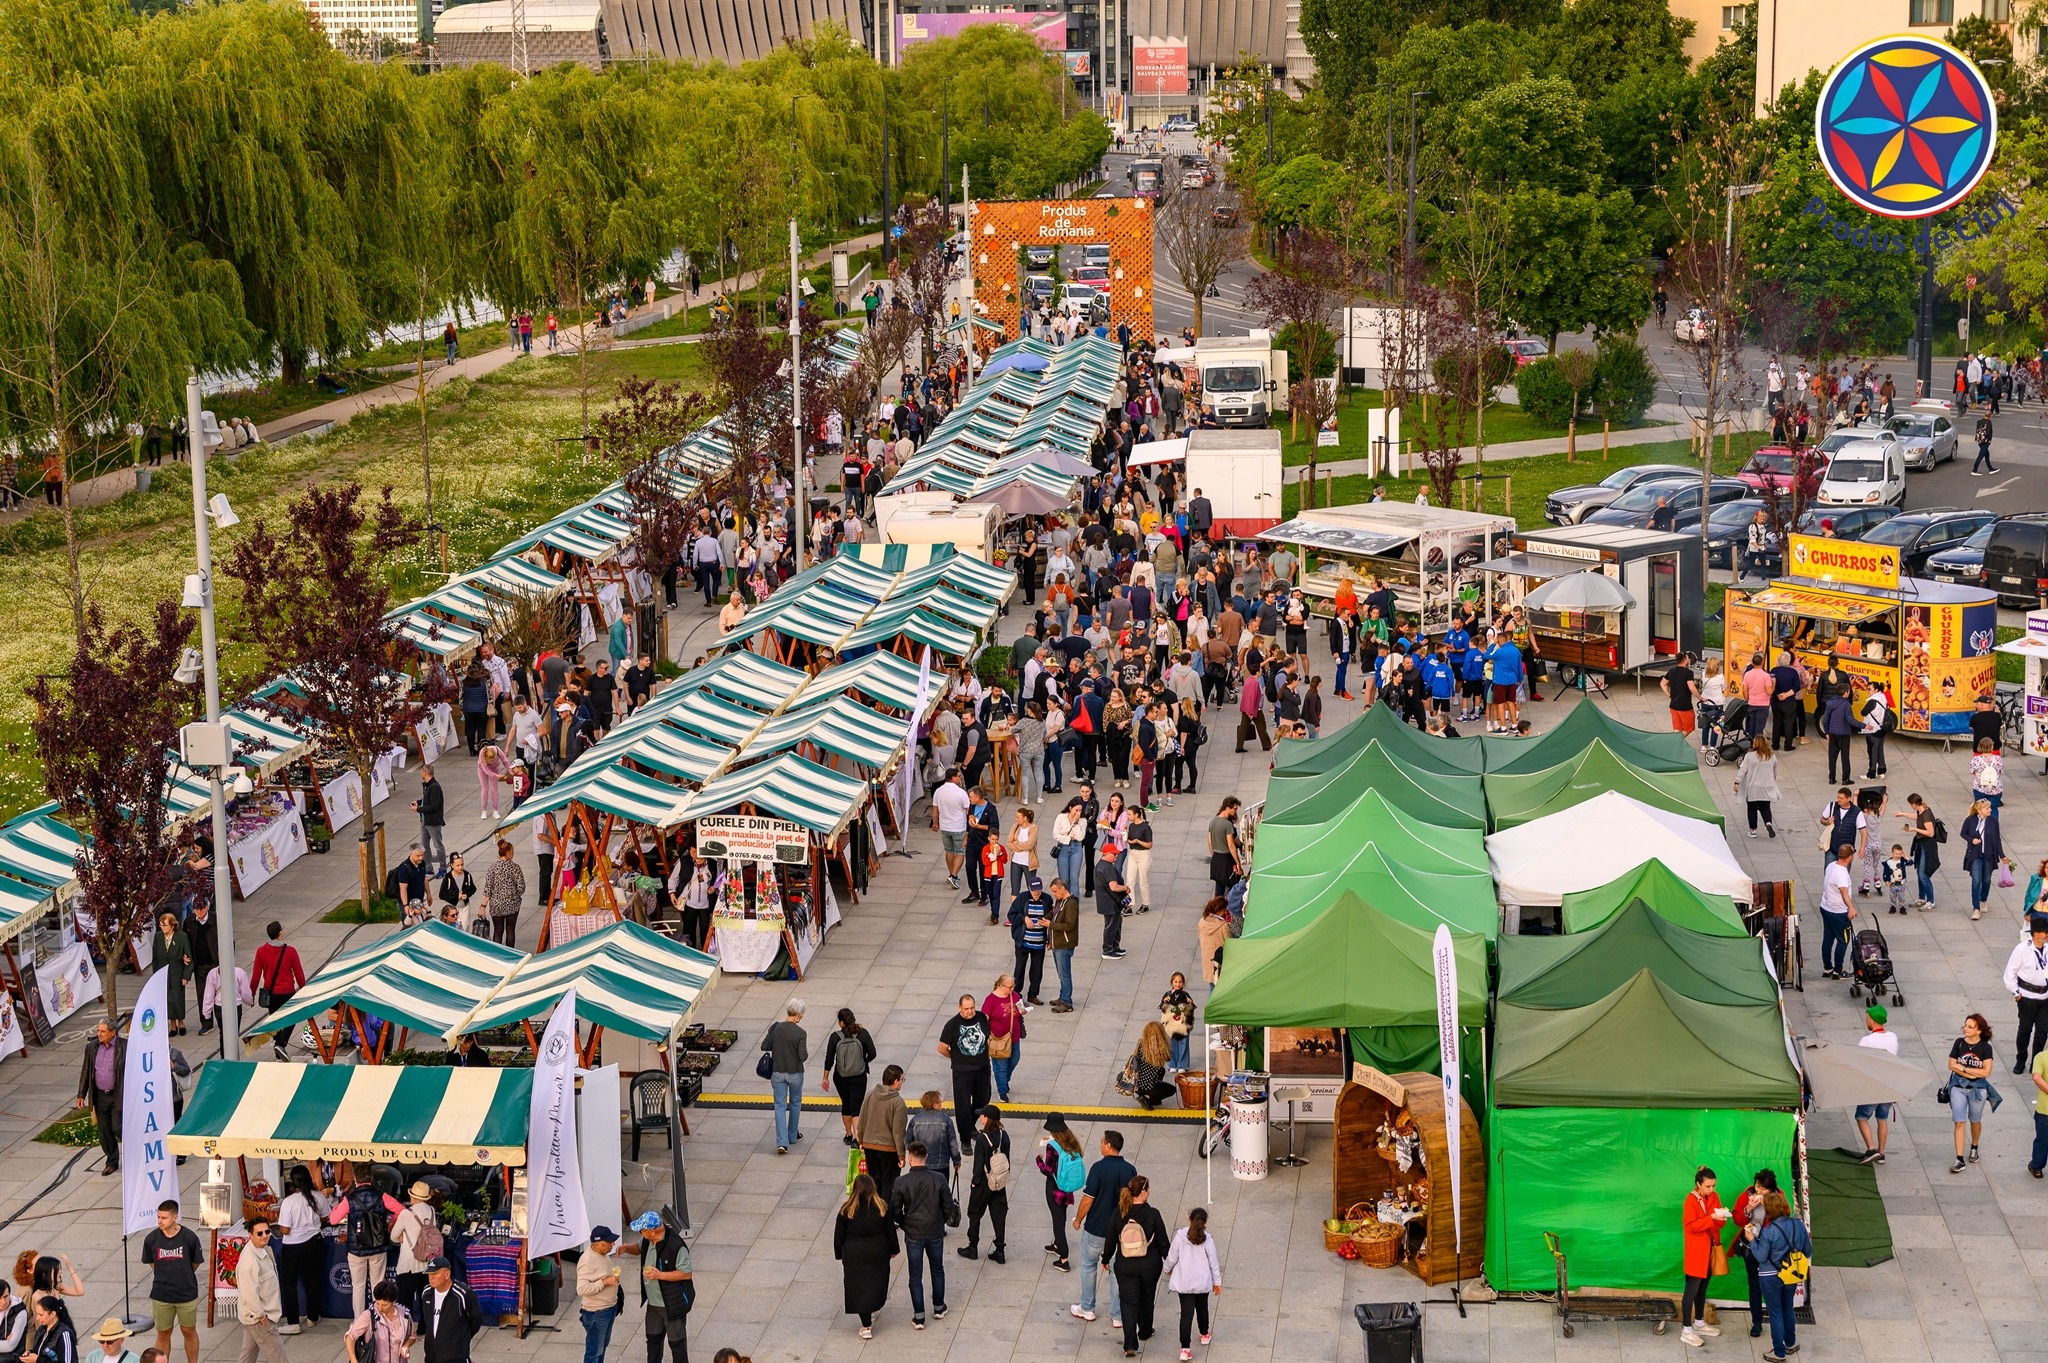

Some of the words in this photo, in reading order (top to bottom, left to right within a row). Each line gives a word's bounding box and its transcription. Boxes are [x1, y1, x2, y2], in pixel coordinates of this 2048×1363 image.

[1042, 204, 1087, 216] Produs
[1055, 216, 1071, 228] de
[1040, 225, 1094, 237] Romania
[1530, 543, 1557, 554] BACLAVA
[1811, 550, 1877, 573] CHURROS
[1780, 591, 1872, 609] CHURROS
[1941, 607, 1953, 658] CHURROS
[1846, 664, 1881, 677] Churros
[516, 780, 520, 790] 5
[700, 817, 745, 829] CURELE
[748, 818, 770, 830] DIN
[774, 821, 806, 834] PIELE
[700, 828, 730, 838] Calitate
[732, 831, 764, 840] maximă
[766, 832, 774, 840] la
[776, 834, 793, 844] preț
[795, 834, 806, 843] de
[728, 840, 775, 849] producător!
[142, 1050, 165, 1192] USAMV
[254, 1147, 305, 1157] ASOCIAȚIA
[323, 1147, 375, 1158] PRODUS
[382, 1149, 399, 1158] DE
[405, 1150, 438, 1160] CLUJ
